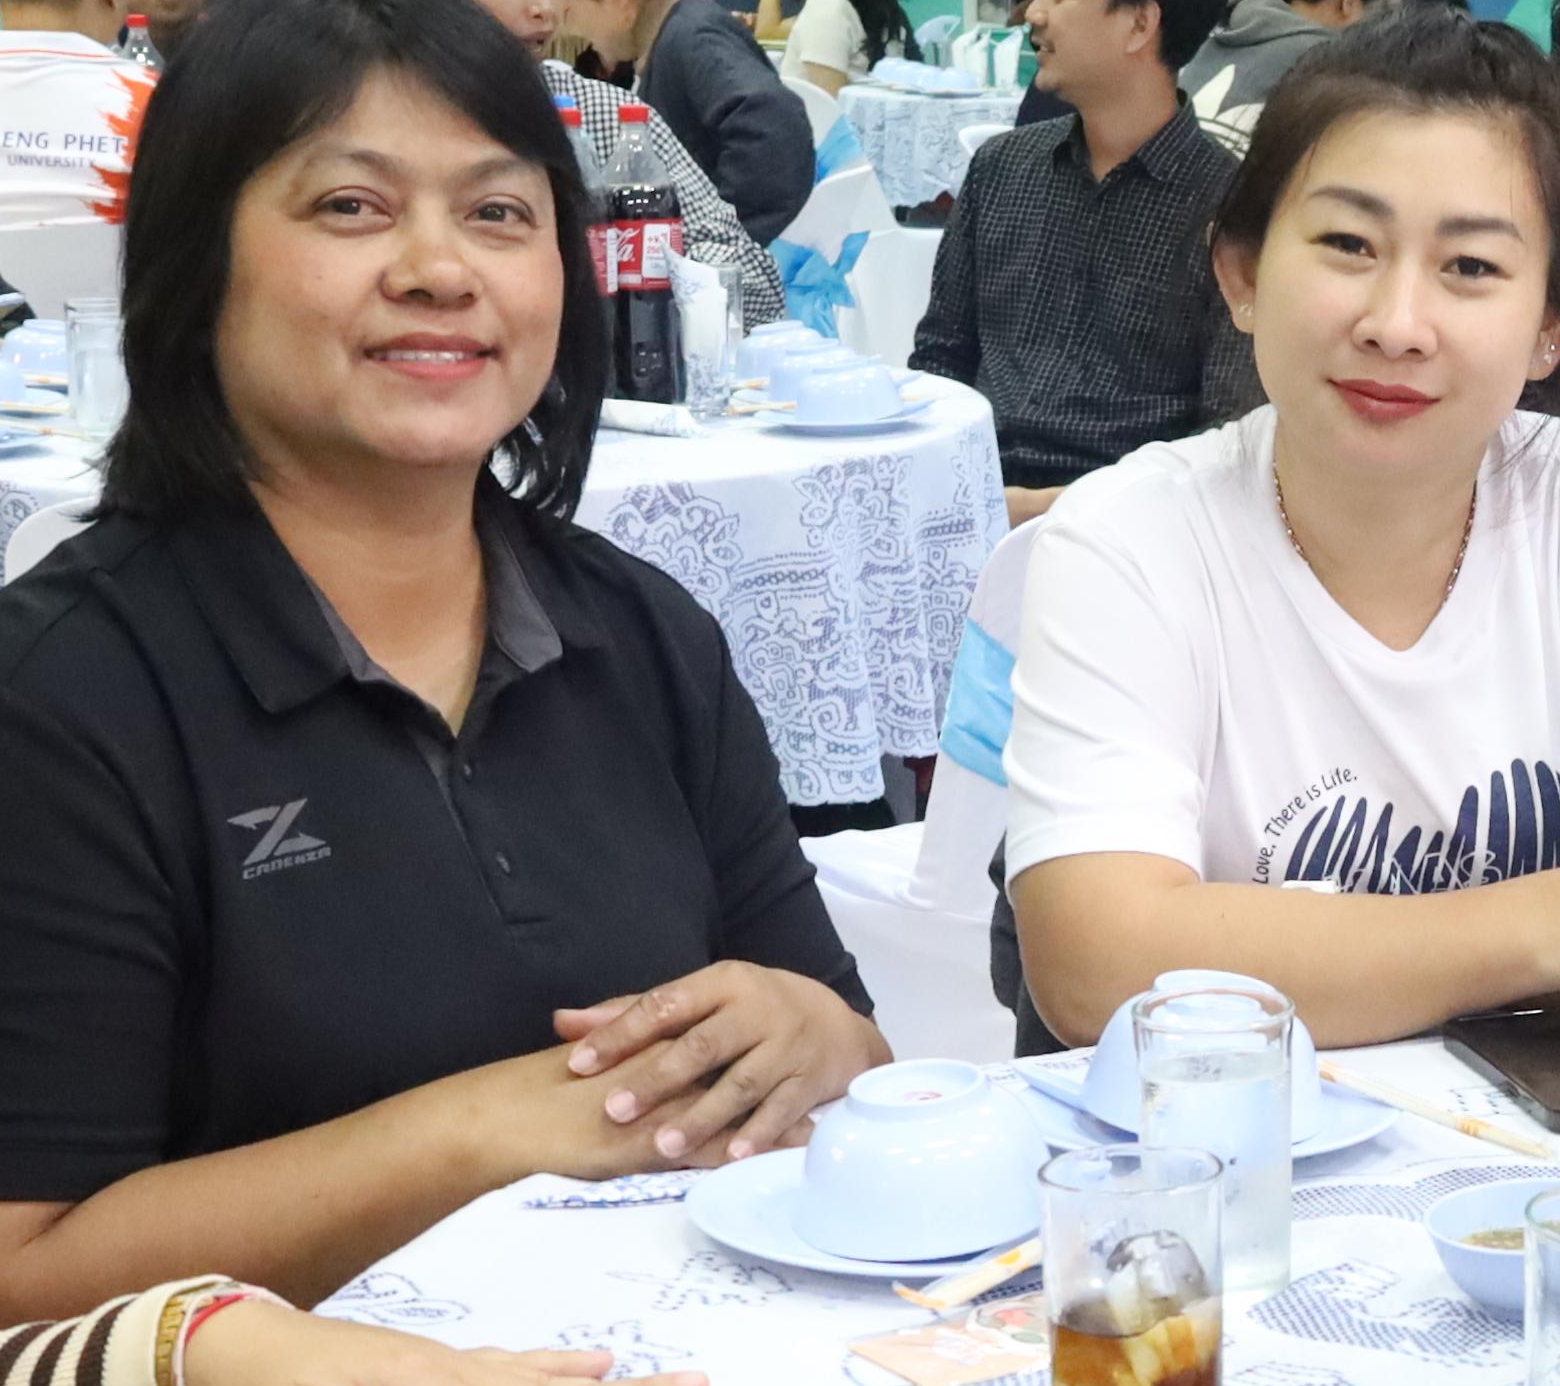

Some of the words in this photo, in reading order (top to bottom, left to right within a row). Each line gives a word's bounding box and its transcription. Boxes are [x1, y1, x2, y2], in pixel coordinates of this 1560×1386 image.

[63, 132, 126, 154] PHET
[7, 154, 96, 169] UNIVERSITY
[1321, 766, 1359, 791] Life.
[1303, 784, 1321, 802] is
[1263, 796, 1307, 837] There
[242, 845, 332, 880] CADENZA
[1251, 844, 1277, 885] Love.
